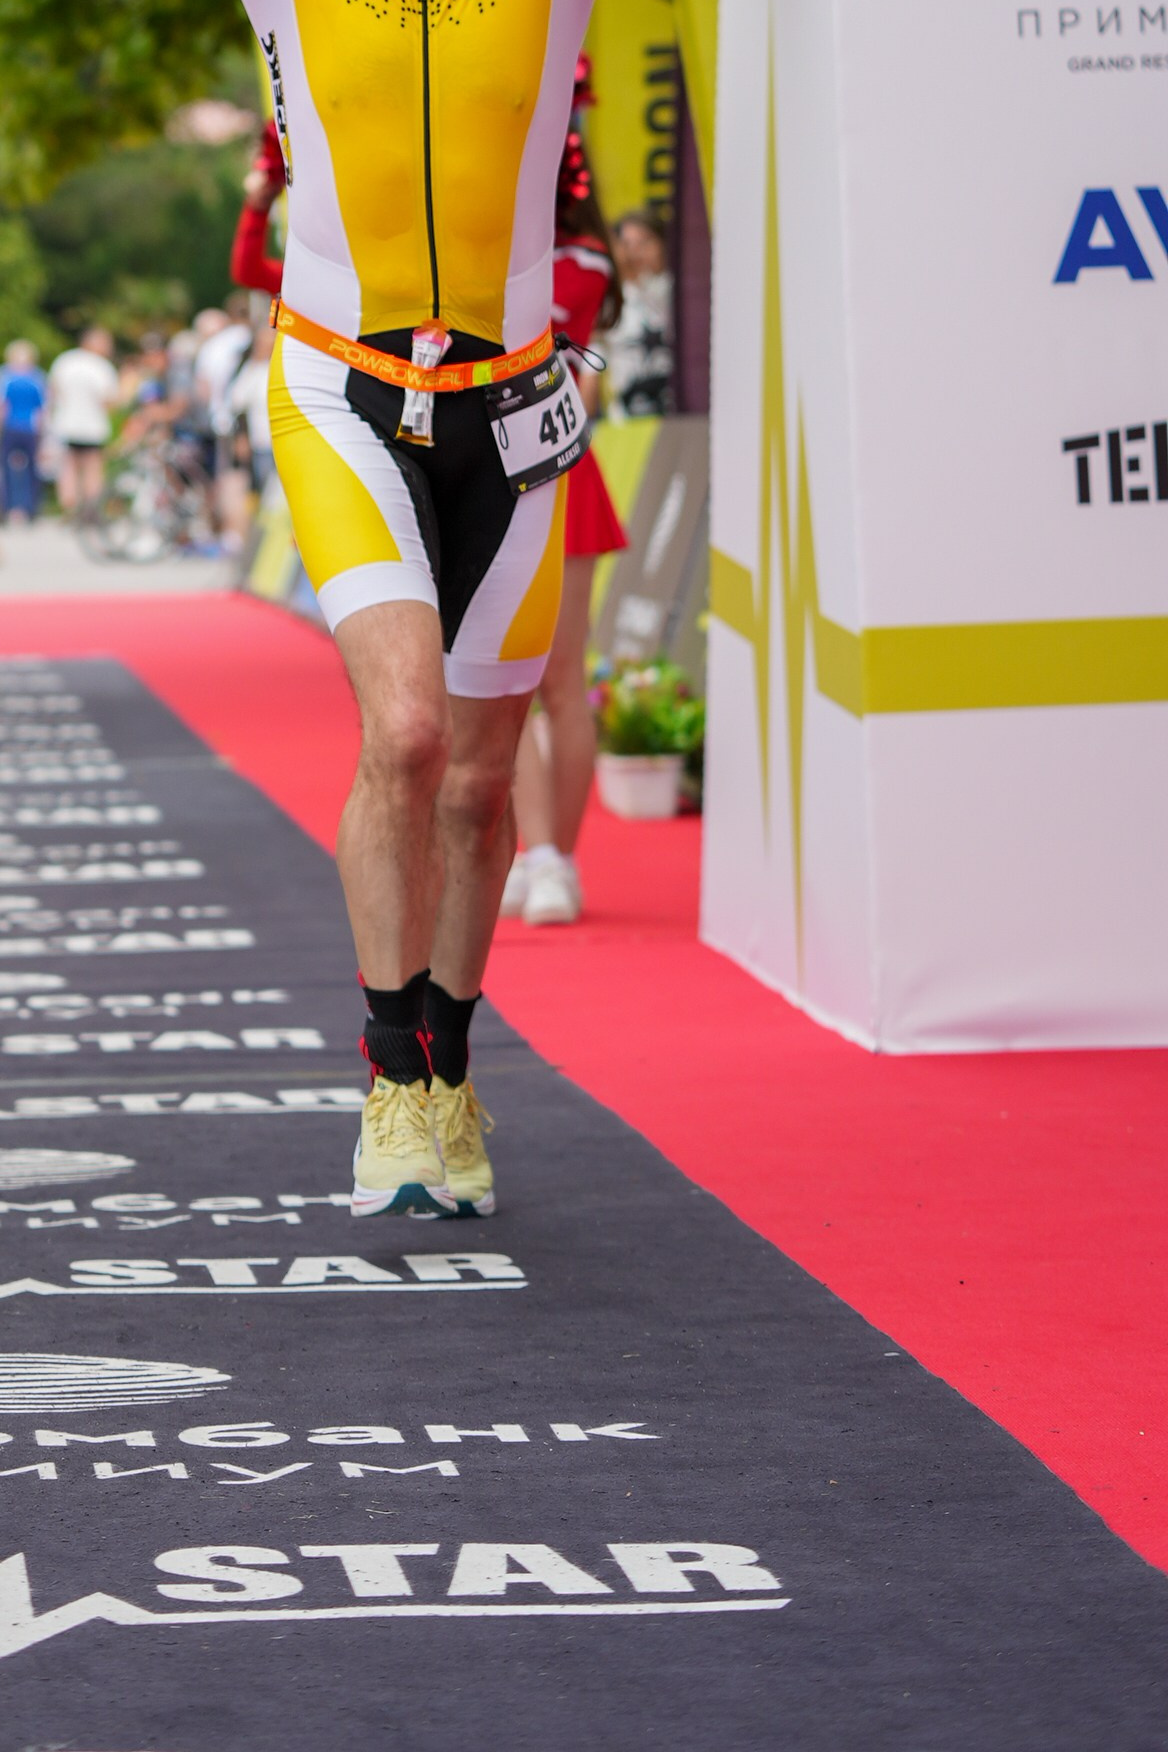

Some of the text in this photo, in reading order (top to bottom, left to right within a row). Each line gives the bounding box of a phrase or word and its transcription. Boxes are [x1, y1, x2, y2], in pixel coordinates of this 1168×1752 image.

[1067, 56, 1135, 73] GRAND
[539, 392, 576, 445] 413
[68, 1252, 526, 1287] STAR
[153, 1542, 783, 1603] STAR
